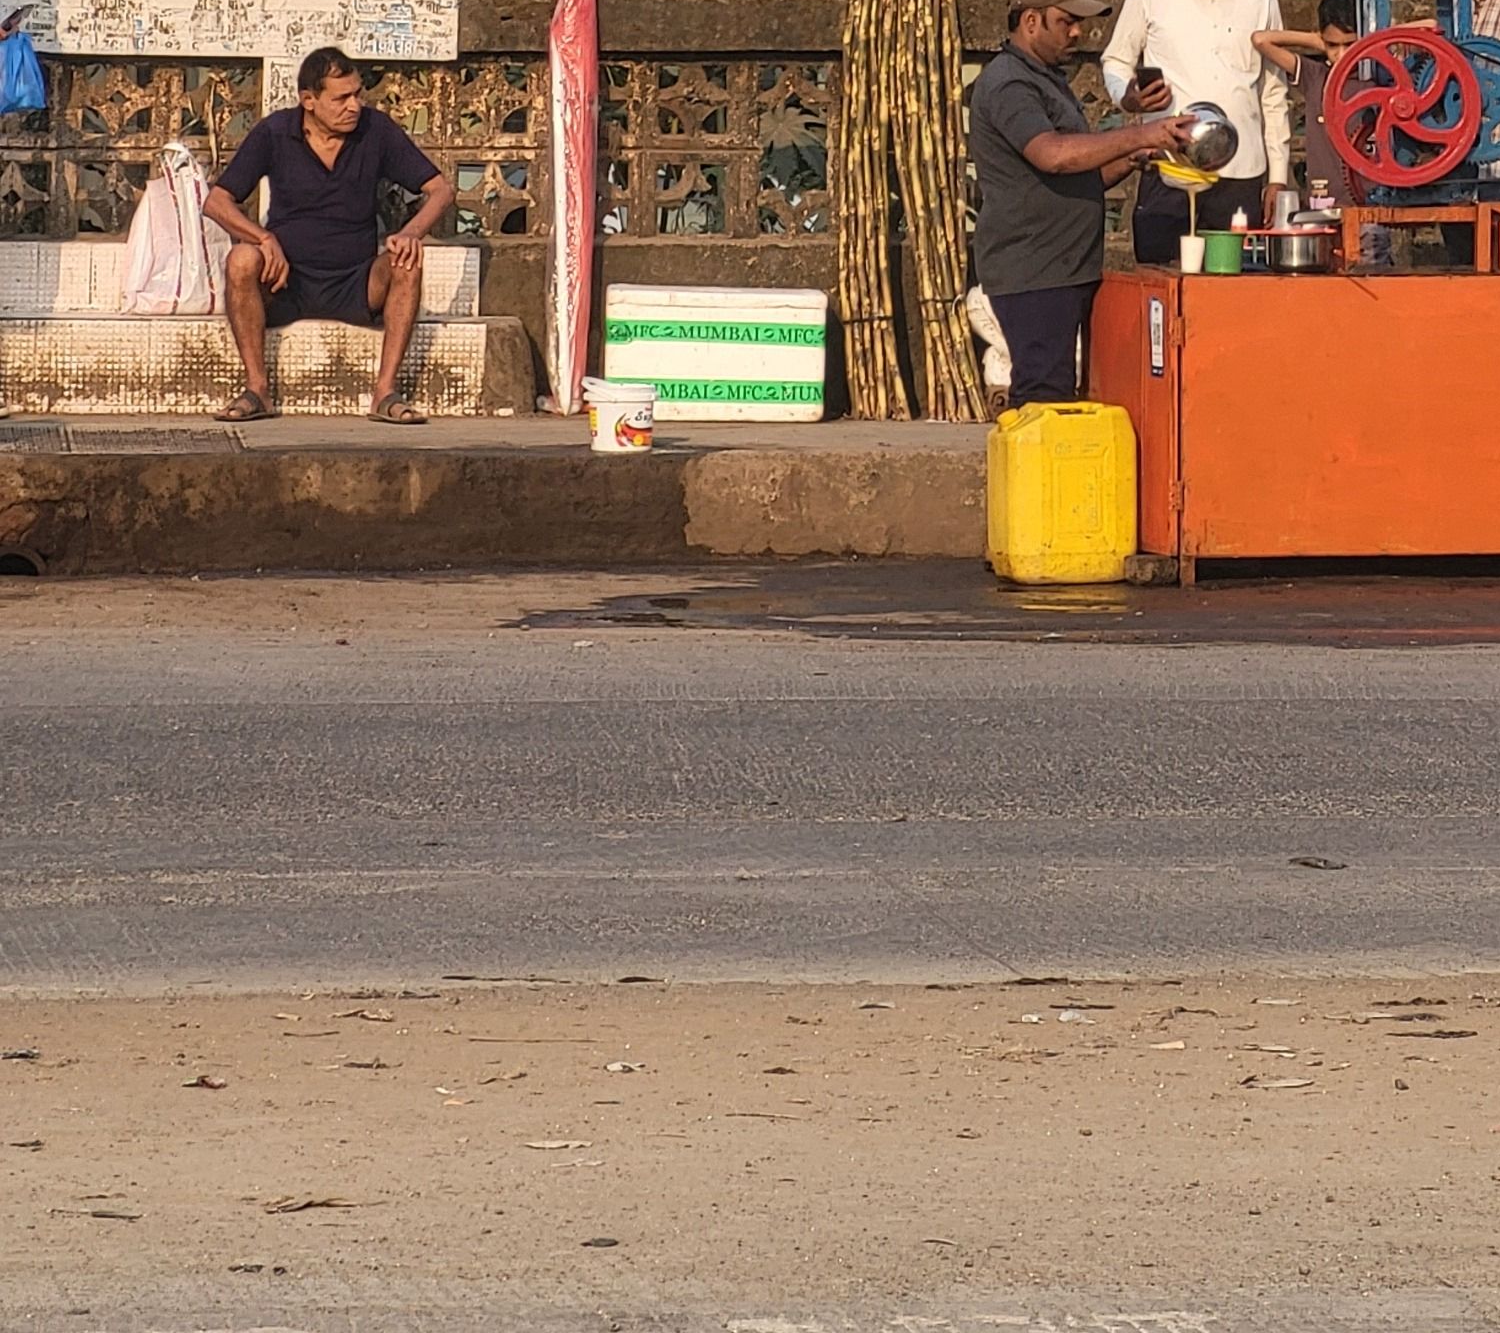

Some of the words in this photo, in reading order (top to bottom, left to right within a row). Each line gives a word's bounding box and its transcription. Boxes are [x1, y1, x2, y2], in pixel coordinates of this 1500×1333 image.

[624, 324, 660, 339] MFC
[679, 325, 760, 342] MUMBAI
[779, 328, 815, 344] MFC
[655, 383, 709, 399] MBAI
[727, 384, 763, 400] MFC
